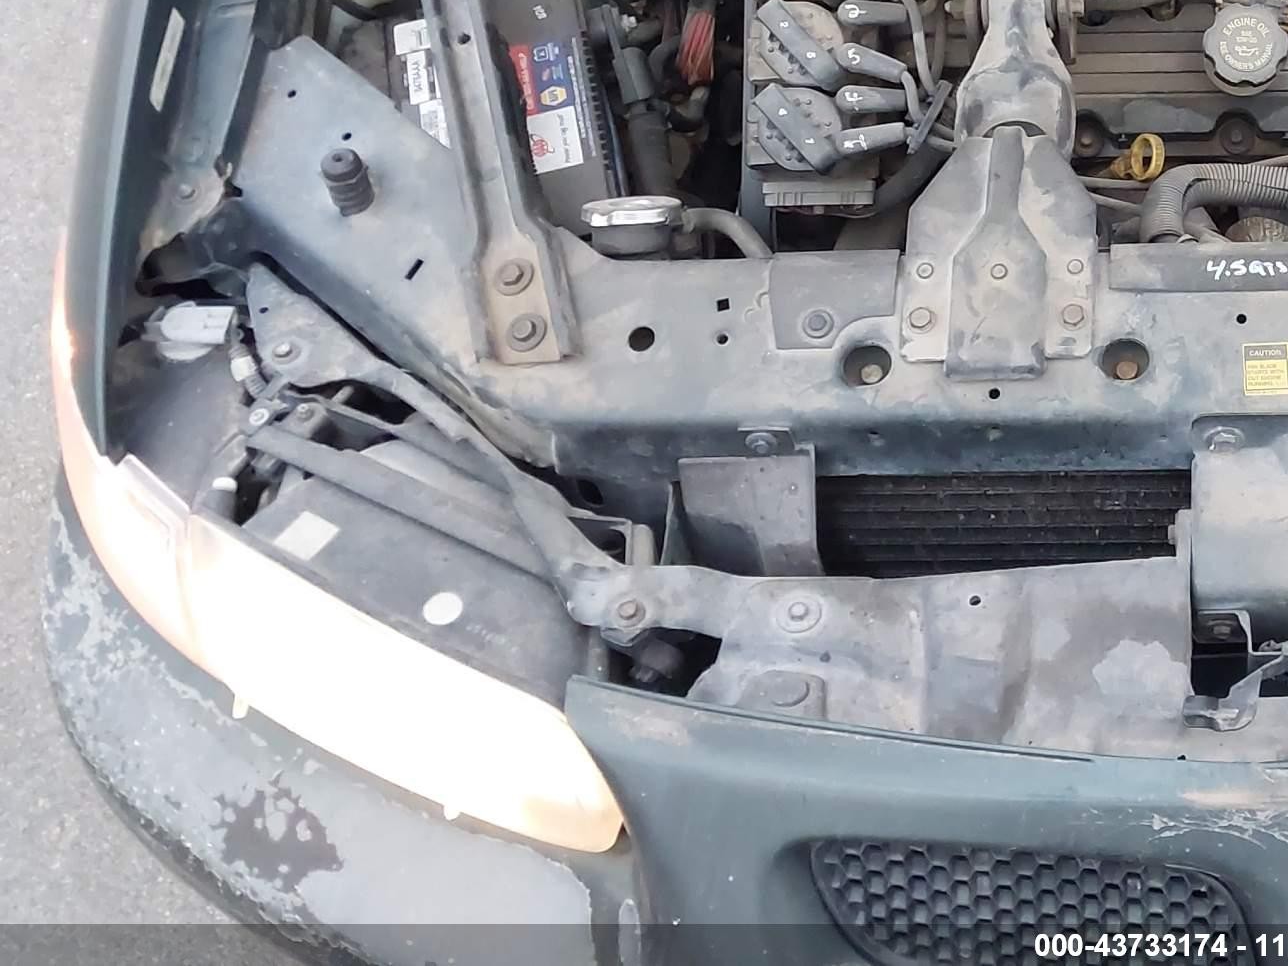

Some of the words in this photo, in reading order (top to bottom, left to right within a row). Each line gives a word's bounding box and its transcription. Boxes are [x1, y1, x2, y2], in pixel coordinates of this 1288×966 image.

[1222, 16, 1258, 36] ENGINE
[1256, 22, 1271, 38] OIL
[847, 48, 861, 65] 5
[1249, 348, 1282, 357] CAUTION
